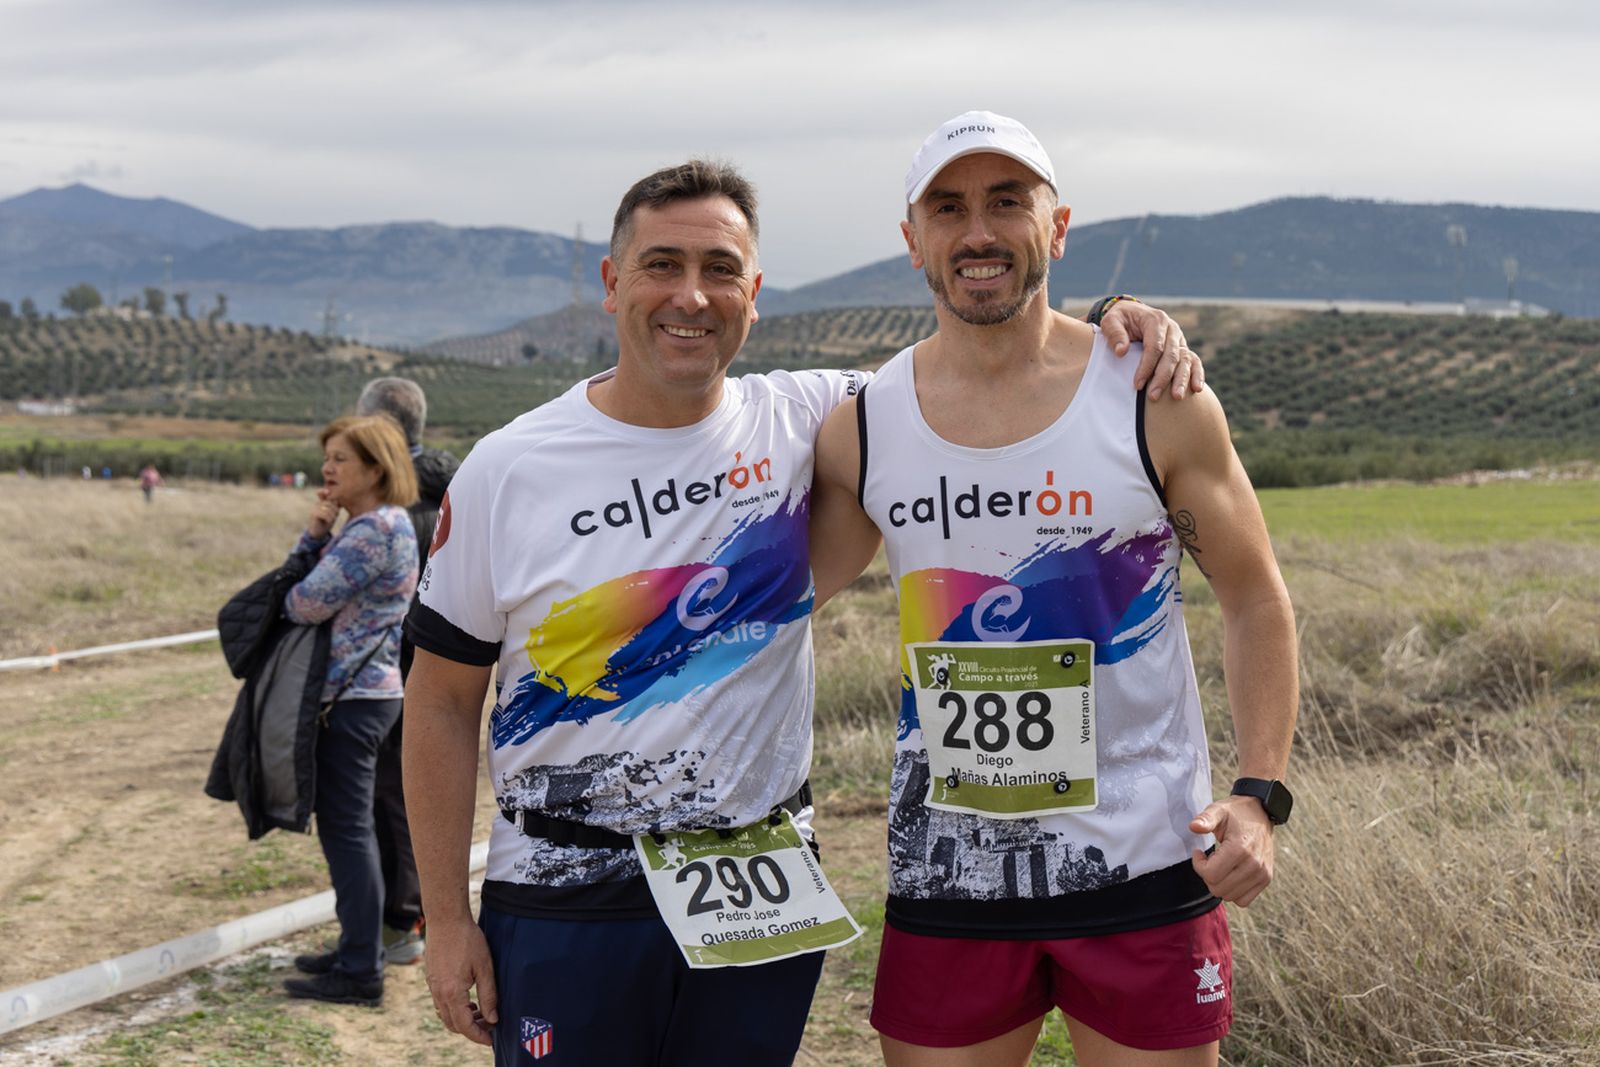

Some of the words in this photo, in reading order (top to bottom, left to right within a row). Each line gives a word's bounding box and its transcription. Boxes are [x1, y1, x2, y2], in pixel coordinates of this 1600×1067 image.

[947, 125, 996, 141] KIPRUN
[570, 450, 772, 539] calderón
[731, 496, 761, 508] desde
[888, 470, 1093, 540] calderón
[1036, 525, 1066, 536] desde
[1070, 525, 1093, 536] 1949
[957, 661, 979, 673] XXVIII
[959, 673, 994, 684] Campo
[996, 674, 1003, 682] a
[1005, 672, 1038, 682] través
[1080, 679, 1089, 689] A
[938, 691, 1055, 753] 288
[1080, 691, 1090, 745] Veterano
[976, 753, 1014, 769] Diego
[951, 767, 989, 786] Mañas
[991, 770, 1068, 787] Alaminos
[800, 850, 826, 894] Veterano
[675, 854, 790, 917] 290
[716, 910, 751, 923] Pedro
[753, 907, 781, 920] Jose
[700, 926, 766, 946] Quesada
[767, 915, 821, 936] Gomez
